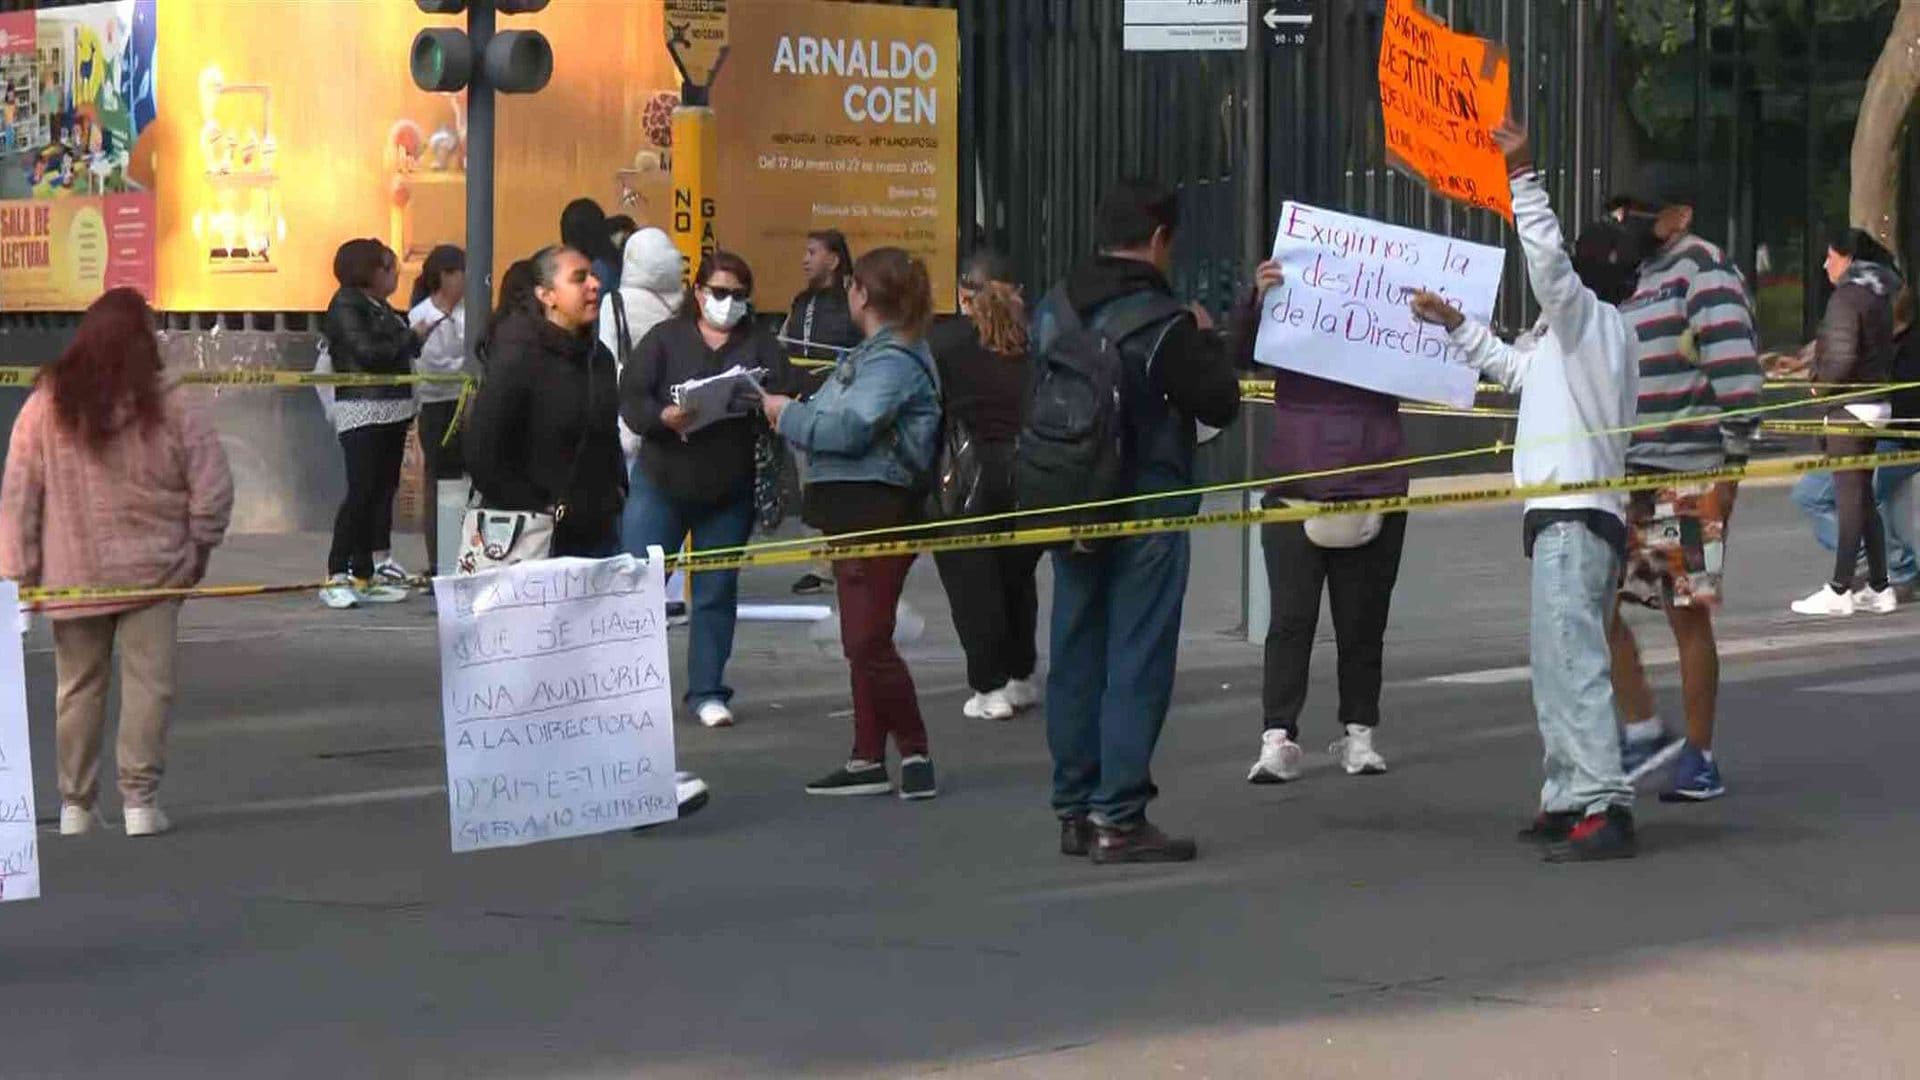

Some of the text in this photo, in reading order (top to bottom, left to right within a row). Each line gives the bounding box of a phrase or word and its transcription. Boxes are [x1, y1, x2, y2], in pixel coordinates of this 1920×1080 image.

[772, 36, 939, 81] ARNALDO
[843, 84, 938, 125] COEN
[0, 206, 50, 237] SALA DE
[674, 188, 691, 233] NO
[0, 240, 50, 269] LECTURA
[1286, 206, 1470, 276] Exigimos la
[1271, 287, 1304, 326] de
[1312, 298, 1337, 334] la
[537, 620, 573, 650] SE
[590, 609, 656, 637] HAGA
[452, 686, 514, 716] UNA
[457, 711, 655, 750] A LA DIRECTORA
